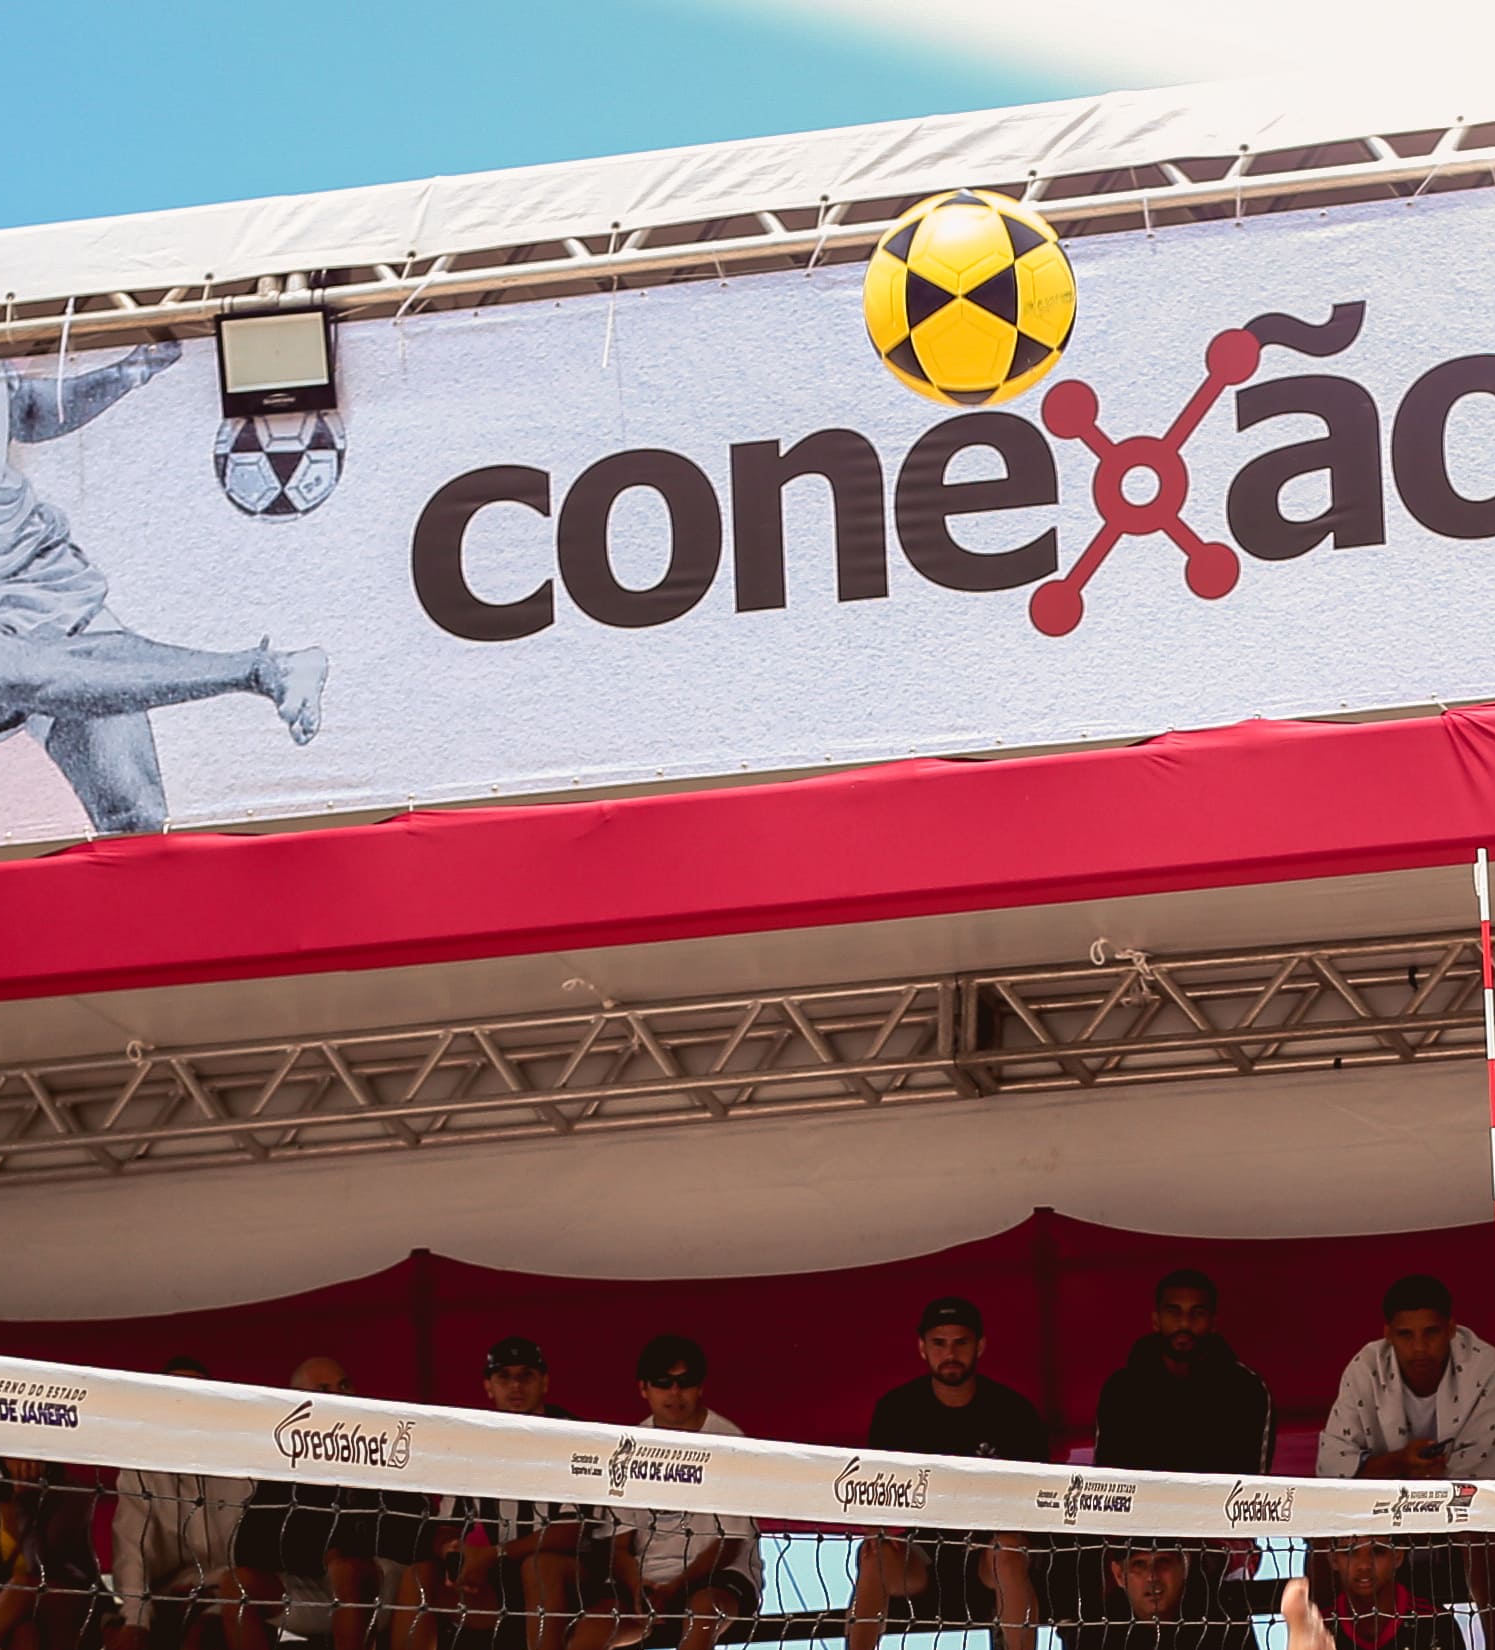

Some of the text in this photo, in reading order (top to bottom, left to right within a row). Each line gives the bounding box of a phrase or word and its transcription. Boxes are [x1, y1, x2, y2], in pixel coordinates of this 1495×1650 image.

[28, 1383, 45, 1397] DO
[46, 1385, 88, 1401] ESTADO
[290, 1421, 388, 1468] predialnet
[629, 1460, 648, 1480] RIO
[649, 1461, 664, 1482] DE
